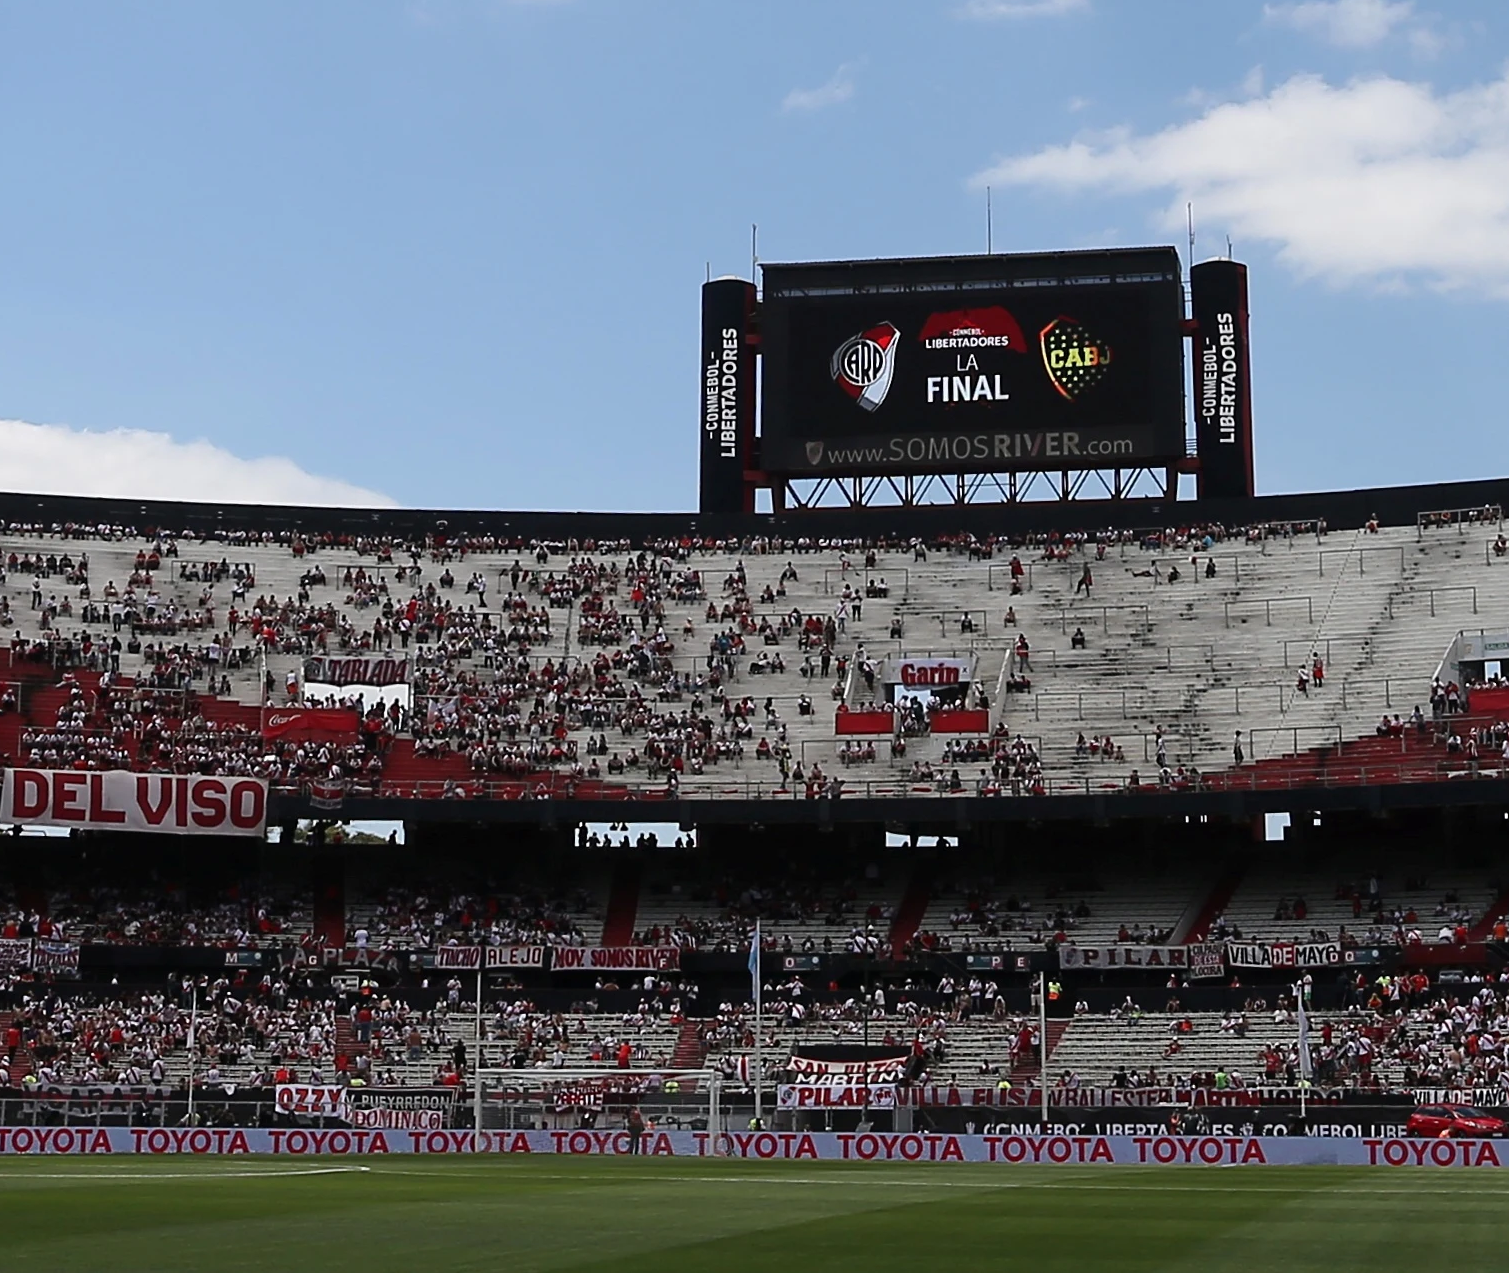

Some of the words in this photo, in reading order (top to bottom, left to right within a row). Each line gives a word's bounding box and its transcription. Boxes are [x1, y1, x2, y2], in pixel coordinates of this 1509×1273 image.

[925, 335, 1009, 349] LIBERTADORES
[956, 354, 979, 372] LA
[1050, 347, 1111, 368] CABJ
[1217, 312, 1236, 444] LIBERTADORES
[720, 328, 738, 458] LIBERTADORES
[927, 374, 1010, 403] FINAL
[828, 431, 1133, 464] www.SOMOSRIVER.com
[329, 658, 409, 684] TABLADA
[12, 769, 126, 823] DEL
[136, 776, 265, 828] VISO
[225, 952, 238, 963] M
[308, 955, 317, 965] G
[323, 947, 400, 973] PLAZA
[488, 948, 542, 965] ALEJO
[660, 960, 667, 968] F
[991, 956, 1001, 968] P
[1017, 956, 1025, 967] E
[1082, 948, 1187, 966] PILAR
[1230, 945, 1271, 965] VILLA
[1273, 947, 1293, 966] DE
[1330, 952, 1338, 962] D
[793, 1059, 829, 1075] SAN
[278, 1087, 341, 1112] OZZY
[361, 1094, 450, 1110] PUEYRREDON
[798, 1087, 873, 1106] PILAR
[896, 1087, 961, 1106] VILLA
[1414, 1089, 1451, 1106] VILLA
[1453, 1089, 1472, 1105] DE
[1474, 1088, 1506, 1106] MAYO
[130, 1129, 250, 1154] TOYOTA
[268, 1131, 389, 1154] TOYOTA
[408, 1131, 532, 1155] TOYOTA
[837, 1134, 964, 1161] TOYOTA
[983, 1137, 1114, 1163] TOYOTA
[1133, 1138, 1266, 1164] TOYOTA
[1363, 1140, 1500, 1167] TOYOTA
